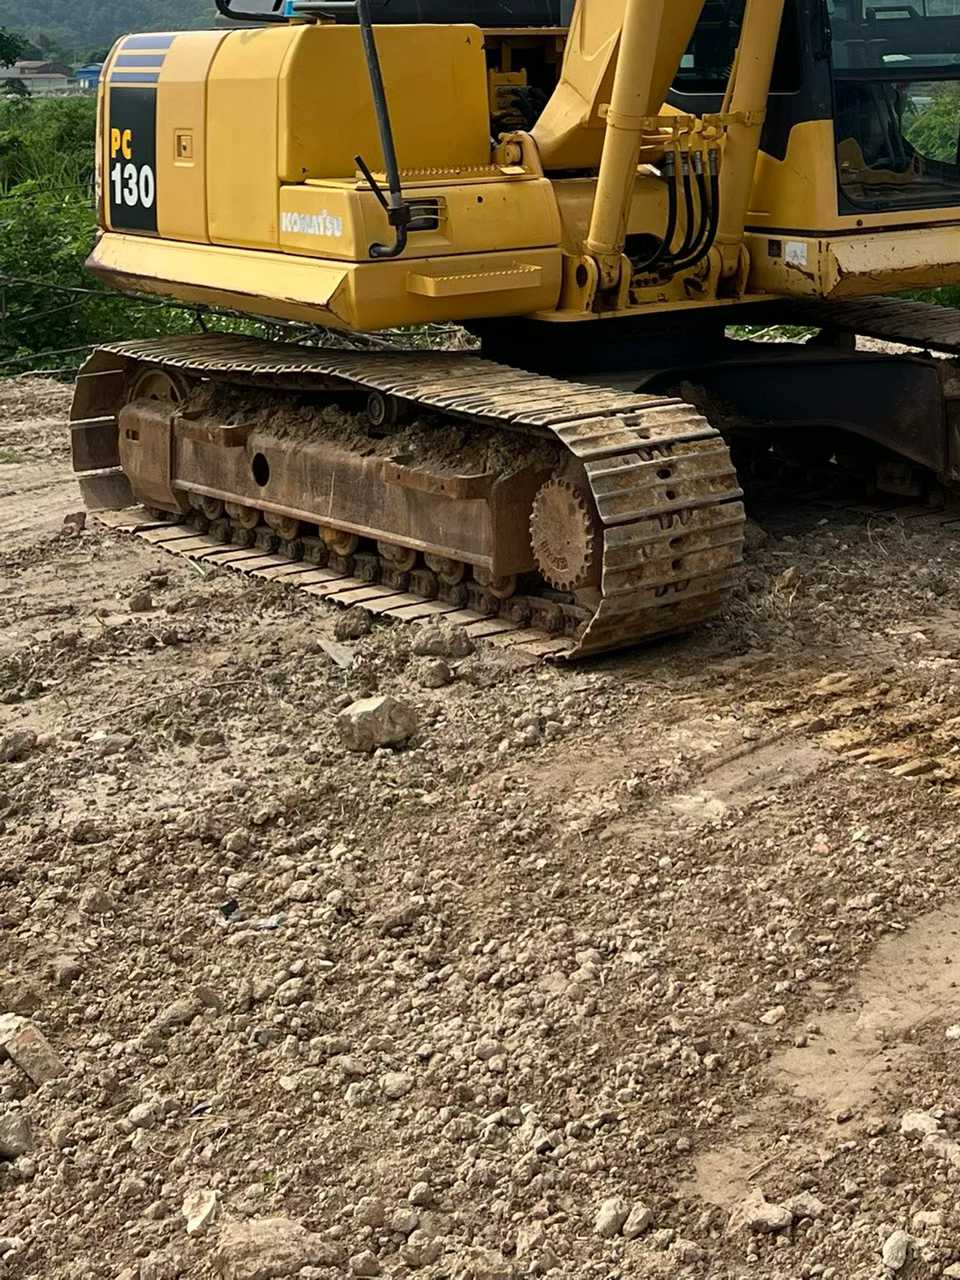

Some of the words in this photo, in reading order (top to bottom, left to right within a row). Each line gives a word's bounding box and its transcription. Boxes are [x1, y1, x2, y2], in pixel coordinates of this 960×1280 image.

[111, 128, 132, 159] PC
[111, 162, 155, 208] 130
[281, 208, 342, 237] KOMATSU
